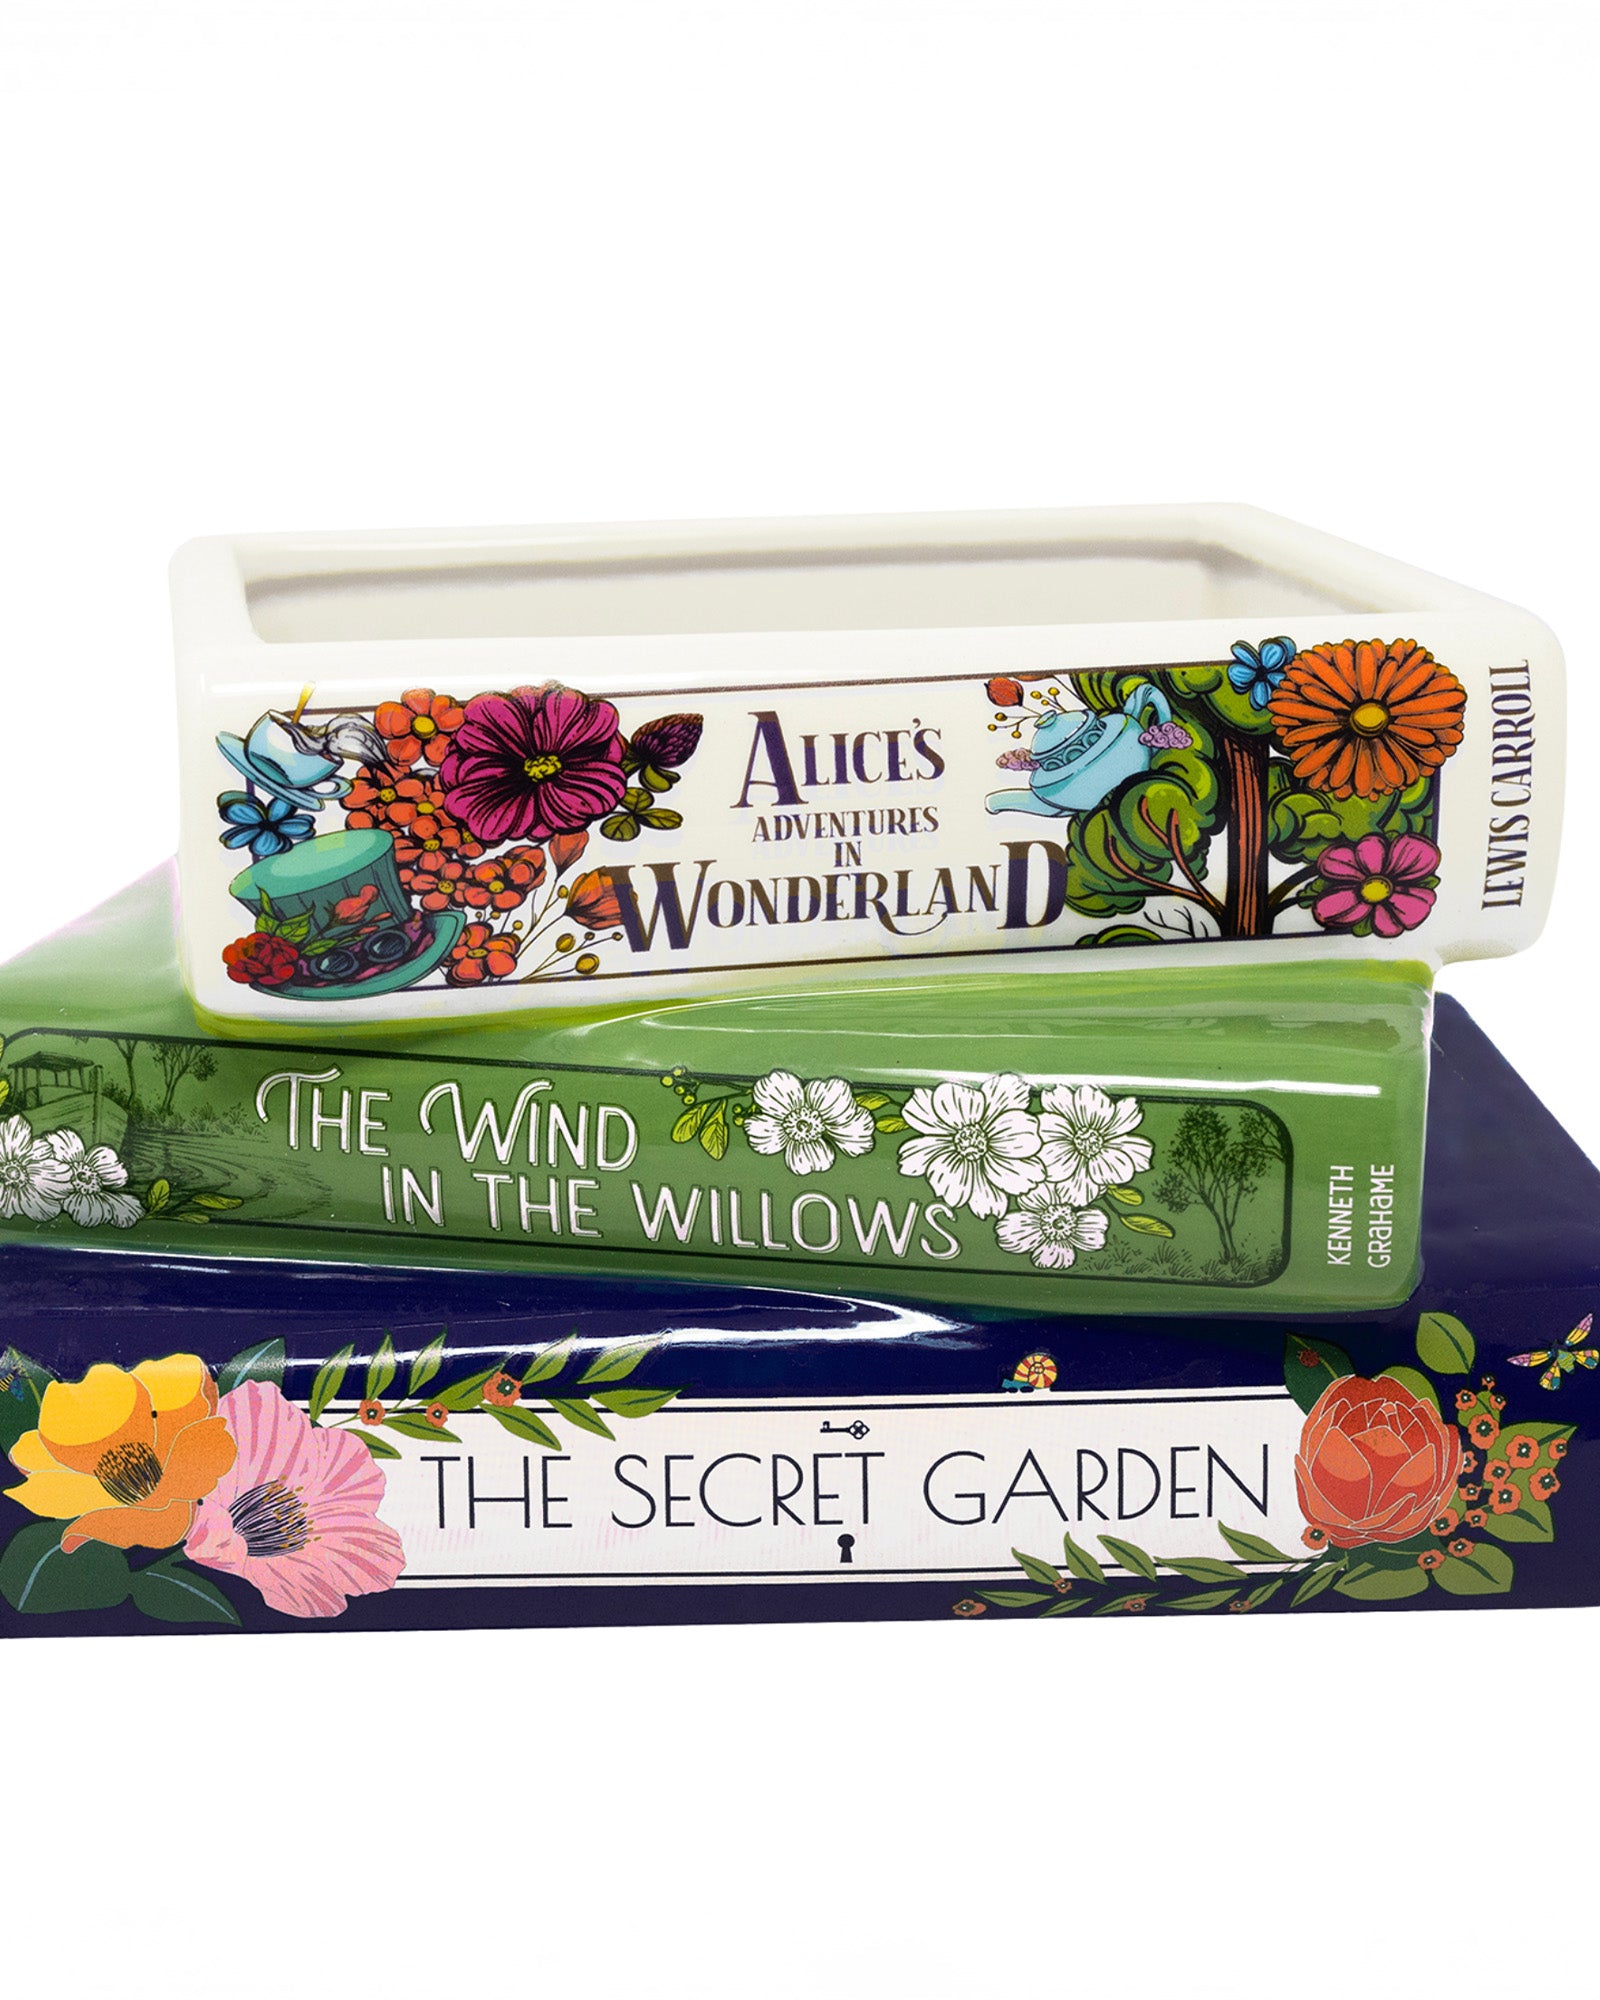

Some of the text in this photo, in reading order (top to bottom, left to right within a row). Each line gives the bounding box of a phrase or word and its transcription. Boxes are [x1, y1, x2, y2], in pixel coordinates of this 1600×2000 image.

[729, 710, 945, 809] ALICE'S
[1481, 659, 1536, 911] LEWIS CARROLL
[751, 806, 939, 843] ADVENTURES
[834, 841, 862, 868] IN
[604, 839, 1069, 953] WONDERLAND
[256, 1063, 640, 1172] THE WIND
[382, 1165, 961, 1260] IN THE WILLOWS
[1327, 1165, 1354, 1266] KENNETH
[420, 1443, 1269, 1529] THE SECRET GARDEN
